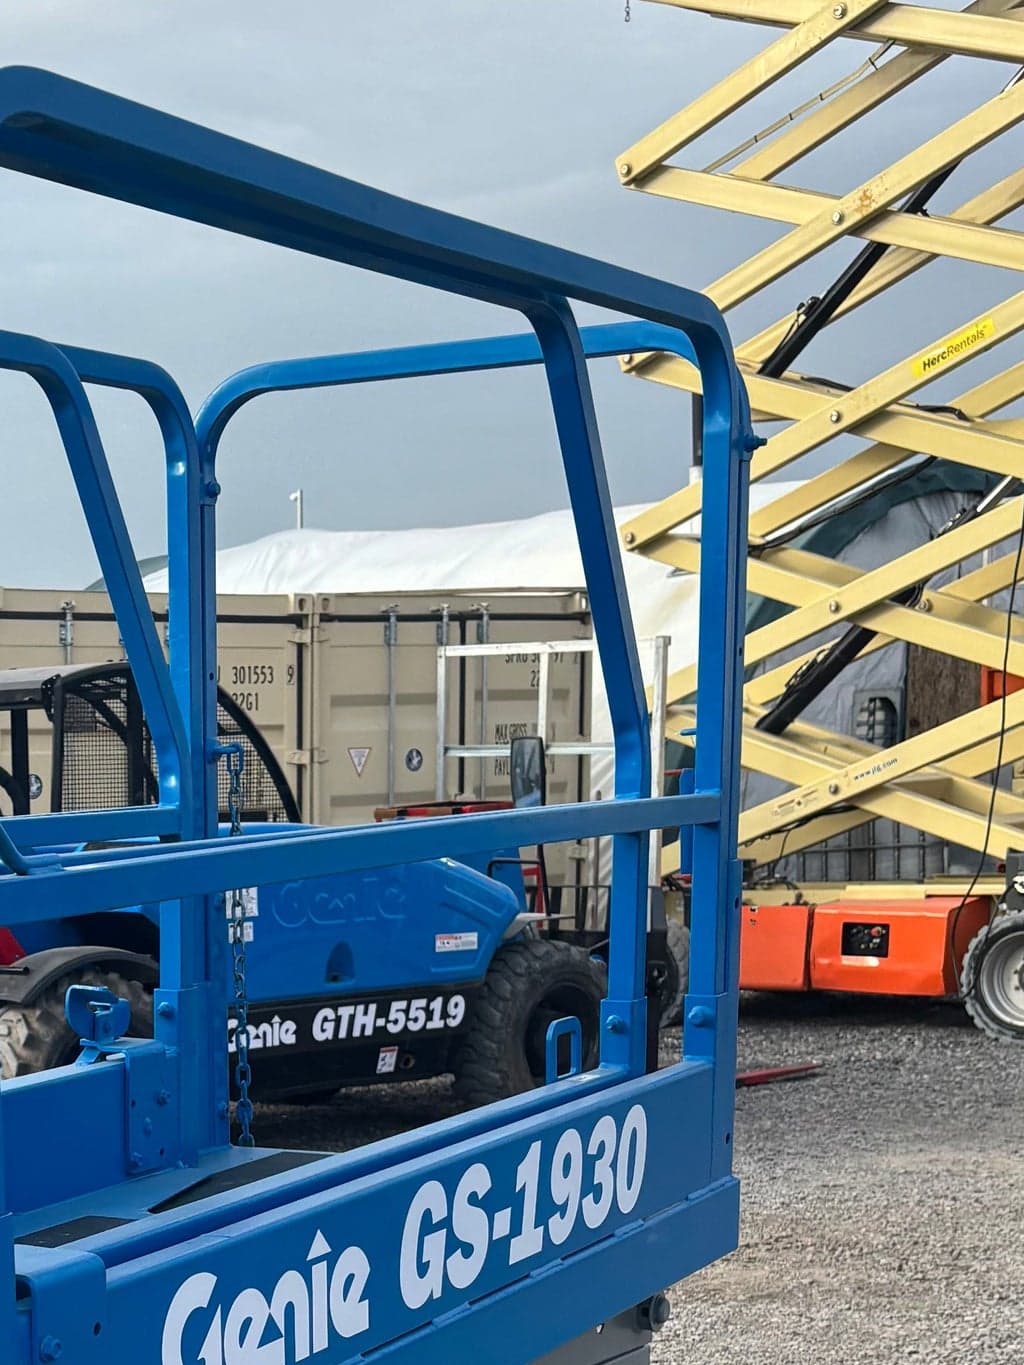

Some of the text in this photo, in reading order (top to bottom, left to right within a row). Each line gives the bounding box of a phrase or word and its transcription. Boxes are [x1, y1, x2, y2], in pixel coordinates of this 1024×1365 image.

[922, 327, 986, 372] HercRentals
[232, 665, 274, 684] 301553
[287, 665, 295, 684] 9
[311, 995, 466, 1042] GTH-5519
[400, 1104, 647, 1310] GS-1930
